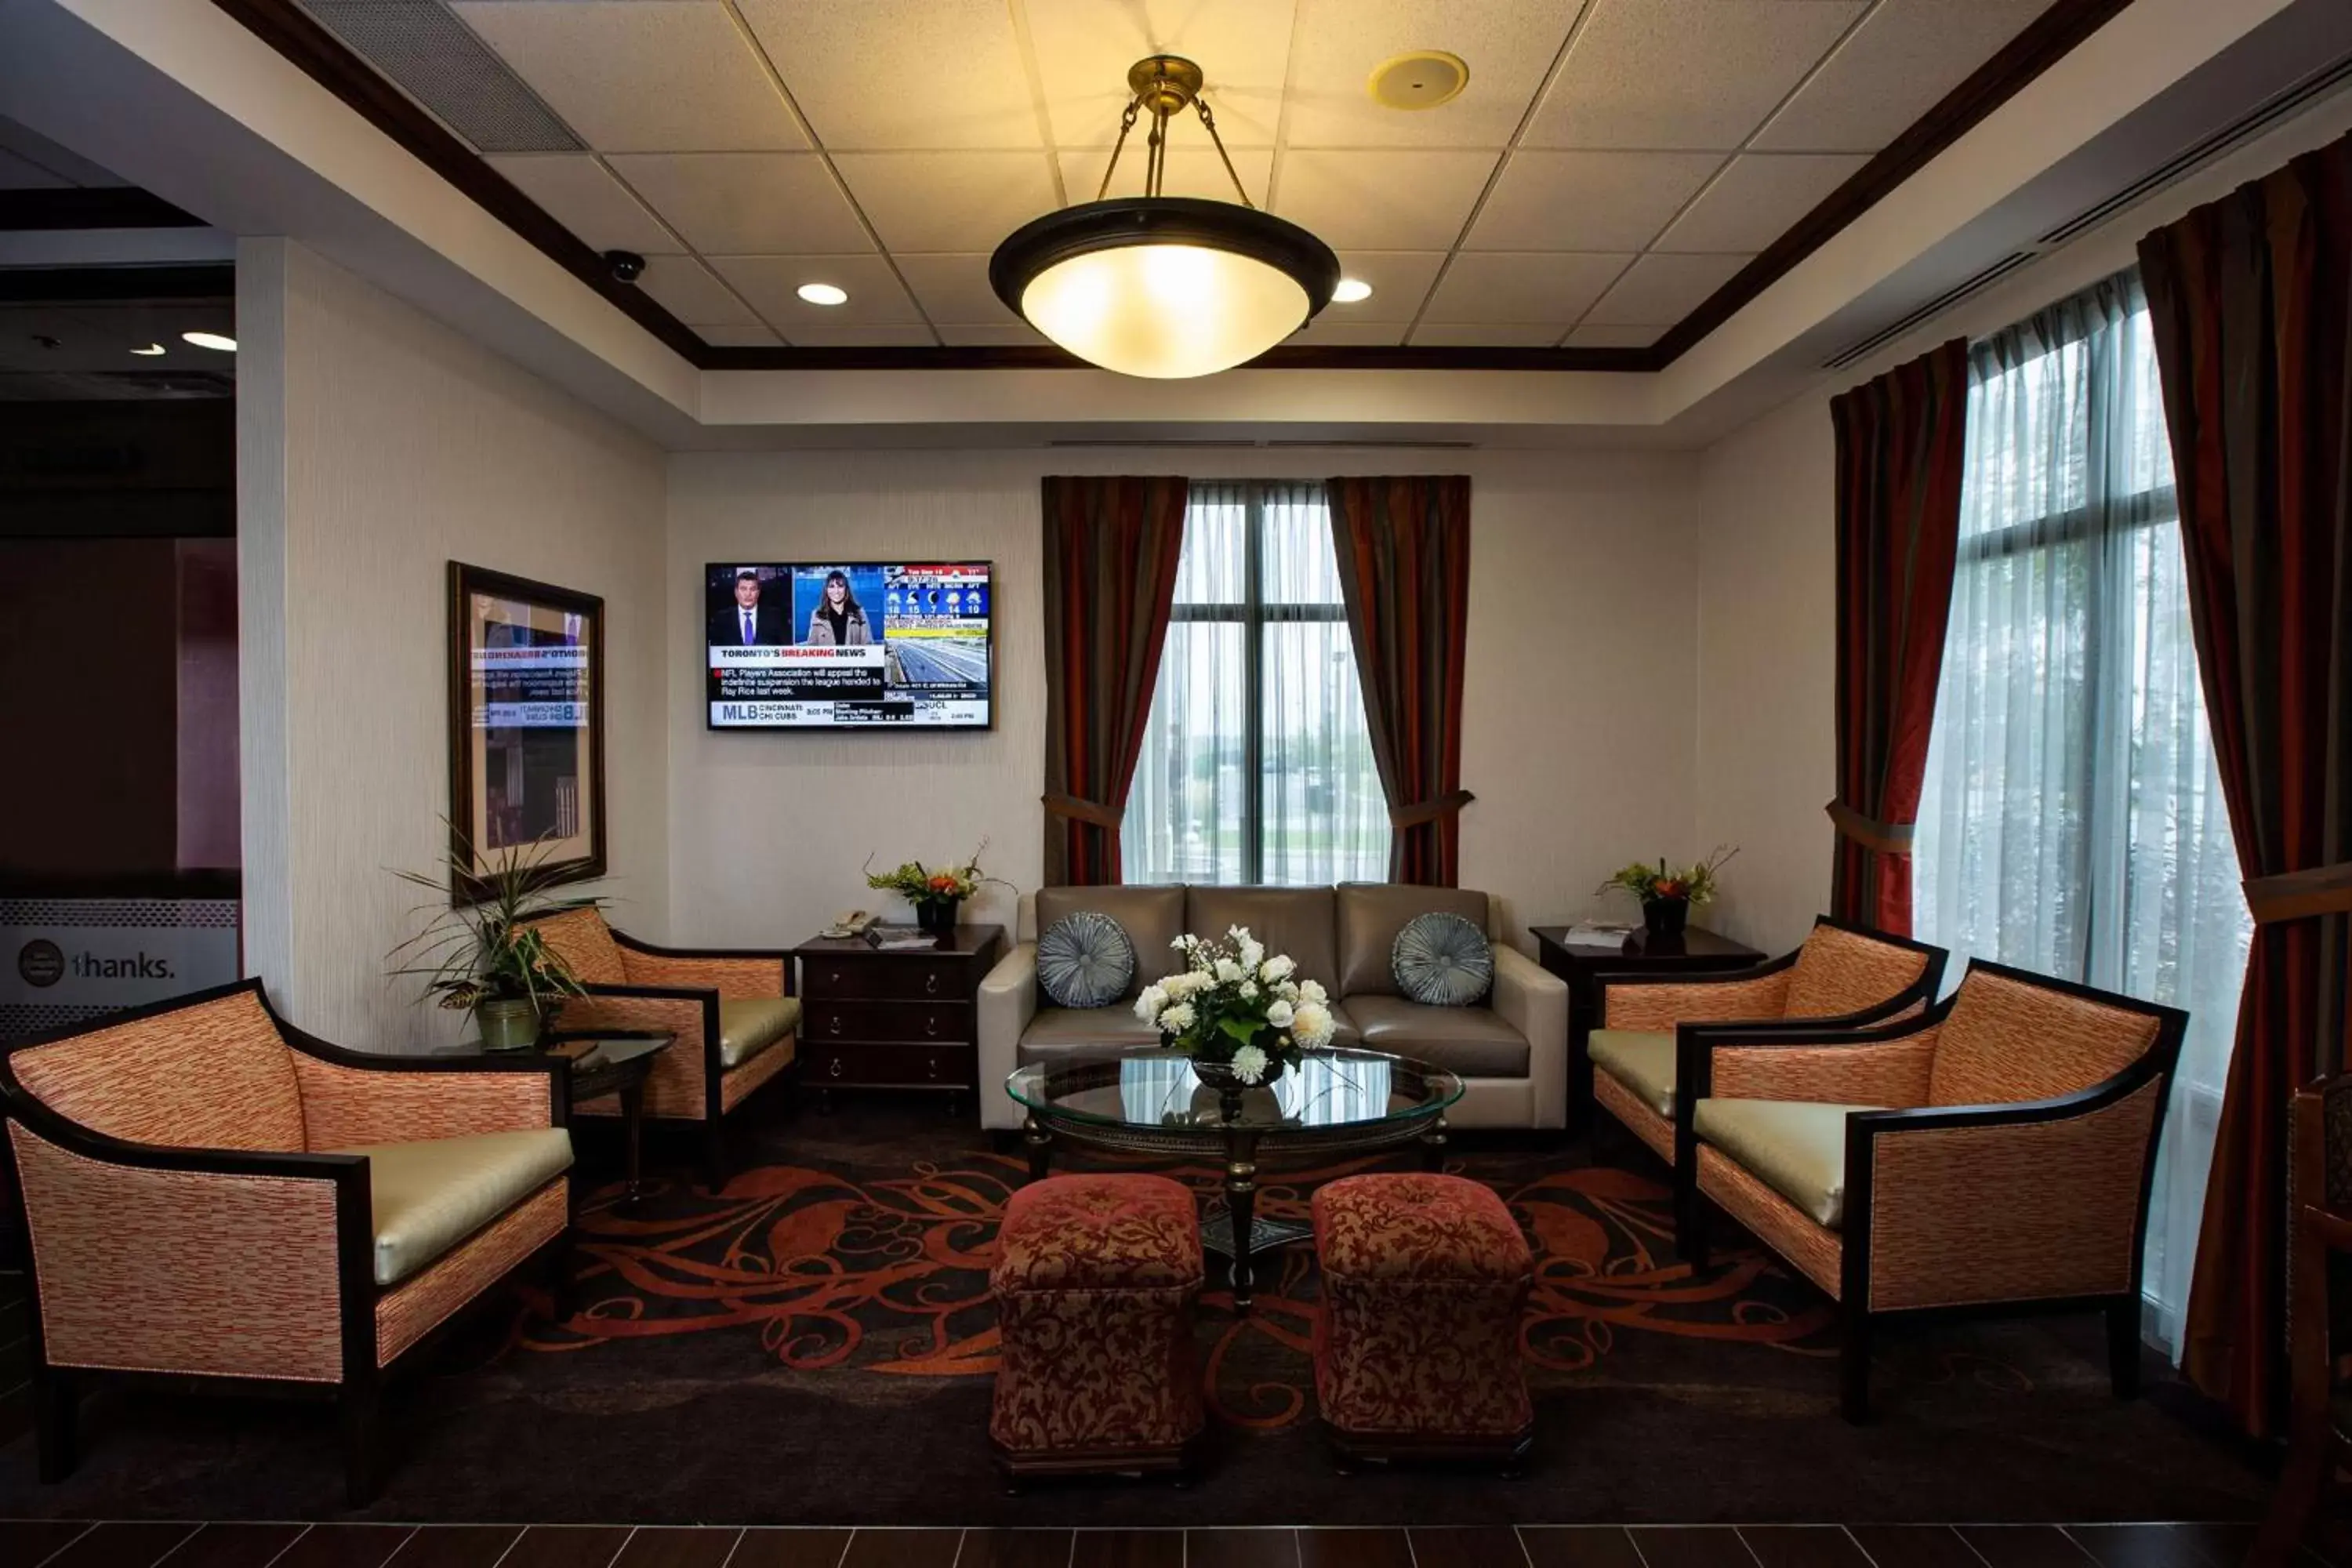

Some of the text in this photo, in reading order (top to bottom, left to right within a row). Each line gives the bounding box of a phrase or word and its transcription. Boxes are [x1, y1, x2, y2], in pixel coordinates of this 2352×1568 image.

[721, 649, 779, 658] TORONTO'S
[721, 669, 737, 677] NFL
[768, 669, 812, 677] Association
[827, 669, 853, 680] appeal
[855, 669, 867, 677] the
[757, 679, 800, 688] suspension
[815, 678, 840, 688] league
[721, 687, 736, 697] Ray
[738, 687, 755, 695] Rice
[757, 687, 771, 695] last
[722, 705, 758, 720] MLB
[72, 950, 175, 979] thanks.
